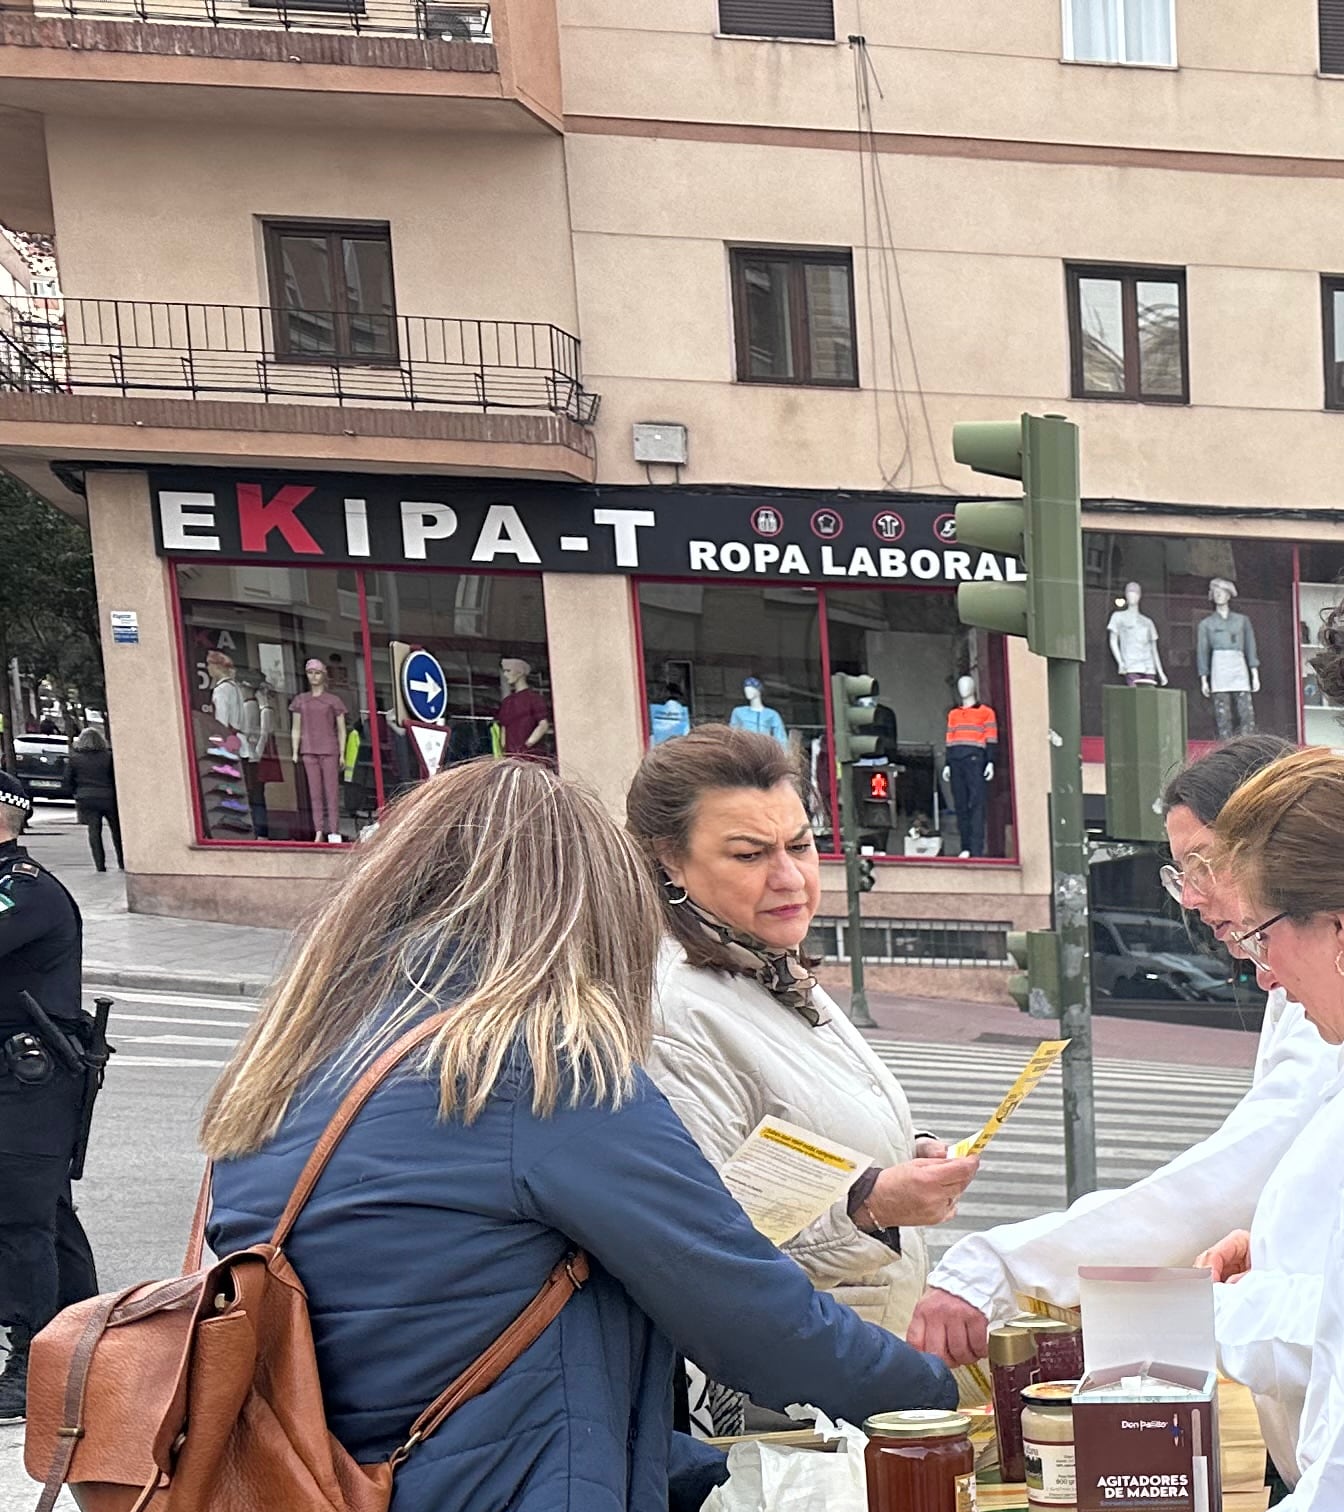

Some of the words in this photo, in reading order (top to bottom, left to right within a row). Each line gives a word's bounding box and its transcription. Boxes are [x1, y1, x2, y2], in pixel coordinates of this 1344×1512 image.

[158, 483, 656, 568] EKIPA-T
[689, 541, 810, 574] ROPA
[820, 546, 1028, 582] LABORAL
[1121, 1420, 1140, 1429] Don
[1096, 1475, 1188, 1487] AGITADORES
[1105, 1487, 1124, 1499] DE
[1127, 1486, 1189, 1498] MADERA
